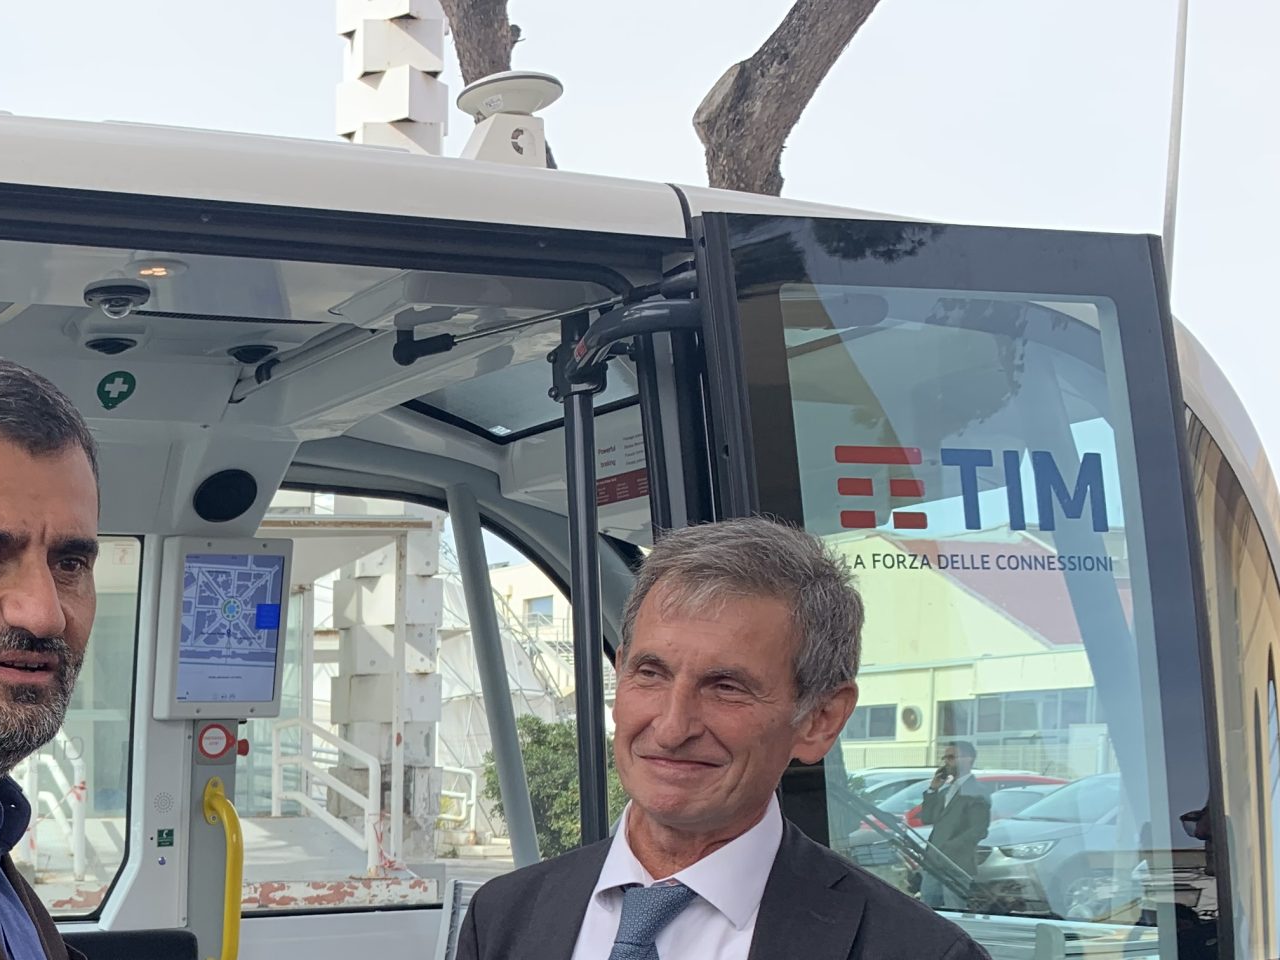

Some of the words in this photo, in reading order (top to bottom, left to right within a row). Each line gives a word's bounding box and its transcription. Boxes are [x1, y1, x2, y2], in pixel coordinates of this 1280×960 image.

[940, 447, 1110, 533] TIM
[872, 553, 933, 570] FORZA
[937, 554, 991, 571] DELLE
[995, 554, 1114, 573] CONNESSIONI
